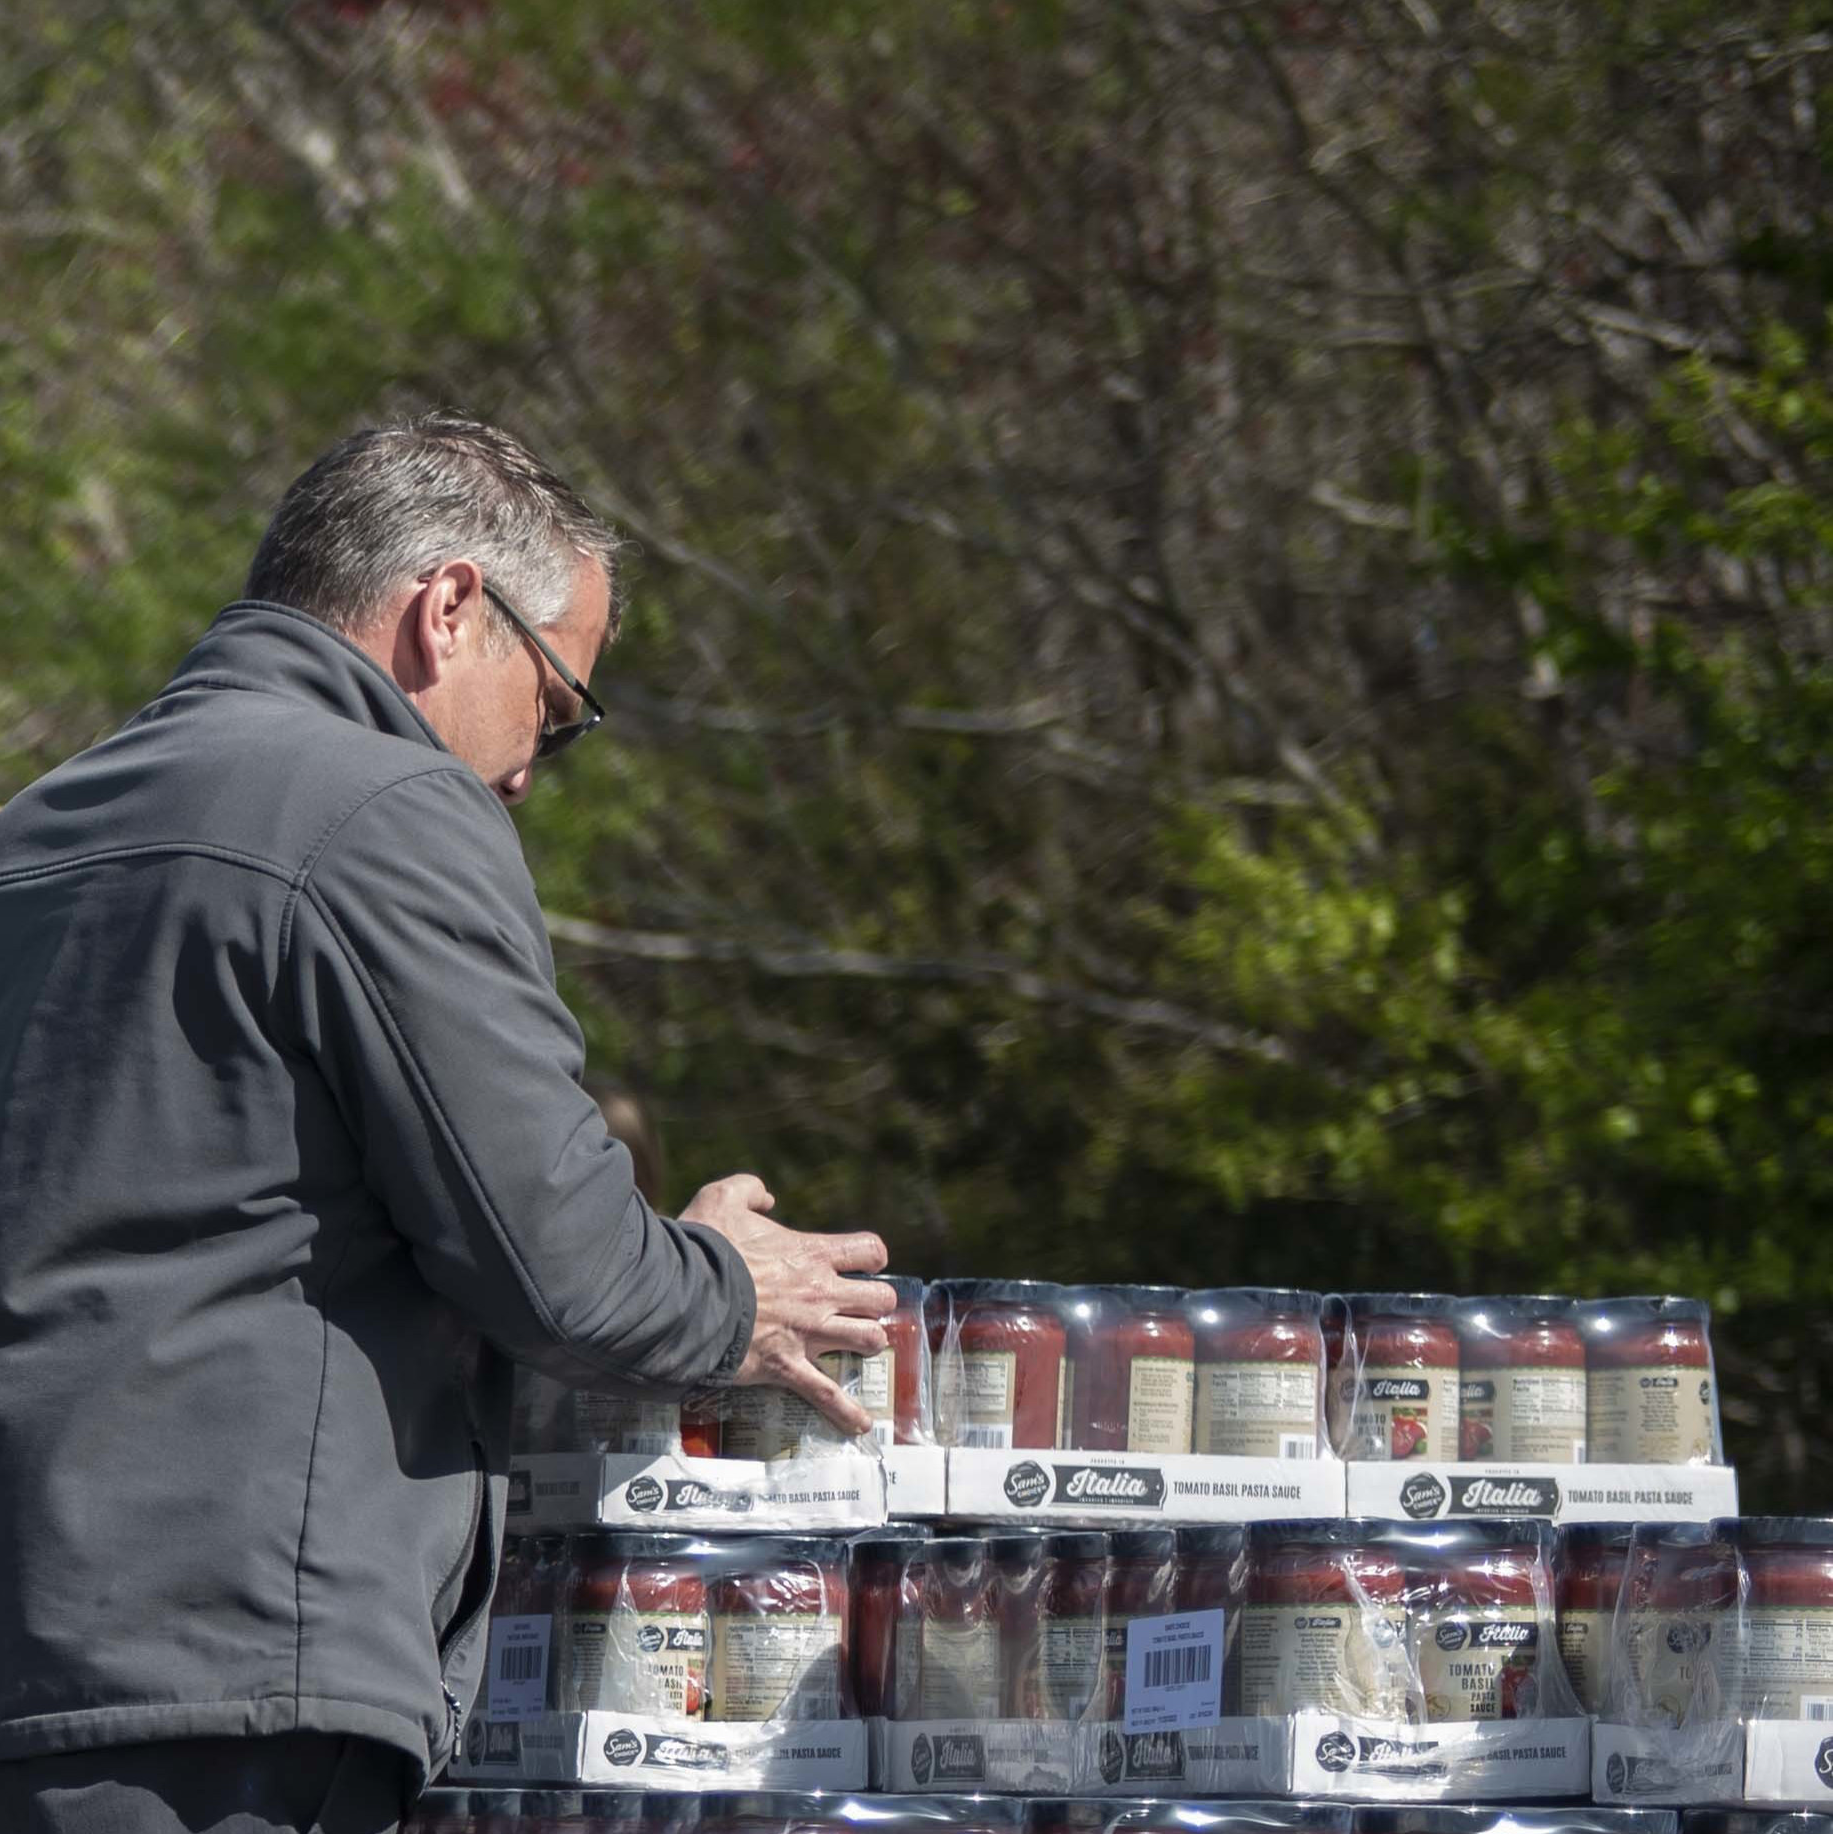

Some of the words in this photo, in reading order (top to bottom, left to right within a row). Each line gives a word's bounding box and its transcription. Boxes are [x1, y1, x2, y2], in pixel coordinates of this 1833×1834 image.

[1373, 1379, 1421, 1396] Italia
[1006, 1473, 1046, 1495] Sam's
[1066, 1467, 1148, 1497] Italia
[1173, 1481, 1210, 1496] TOMATO
[1213, 1482, 1238, 1497] BASIL
[1241, 1482, 1269, 1498] PASTA
[1271, 1484, 1302, 1499] SAUCE
[628, 1485, 660, 1502] Sam's
[789, 1491, 811, 1503] BASIL
[813, 1490, 836, 1502] PASTA
[837, 1489, 860, 1501] SAUCE
[1403, 1484, 1442, 1507] Sam's
[1462, 1479, 1543, 1508] Italia
[1568, 1490, 1604, 1504] TOMATO
[1606, 1490, 1632, 1505] BASIL
[1634, 1490, 1662, 1505] PASTA
[1664, 1491, 1694, 1506] SAUCE
[1479, 1623, 1530, 1642] Italia
[1449, 1663, 1496, 1677] TOMATO
[1461, 1678, 1495, 1690] BASIL
[1470, 1703, 1495, 1713] SAUCE
[605, 1739, 638, 1756] Sam's
[792, 1748, 815, 1760] PASTA
[817, 1747, 841, 1758] SAUCE
[1488, 1748, 1511, 1761] BASIL
[1513, 1747, 1538, 1760] PASTA
[1540, 1746, 1566, 1758] SAUCE
